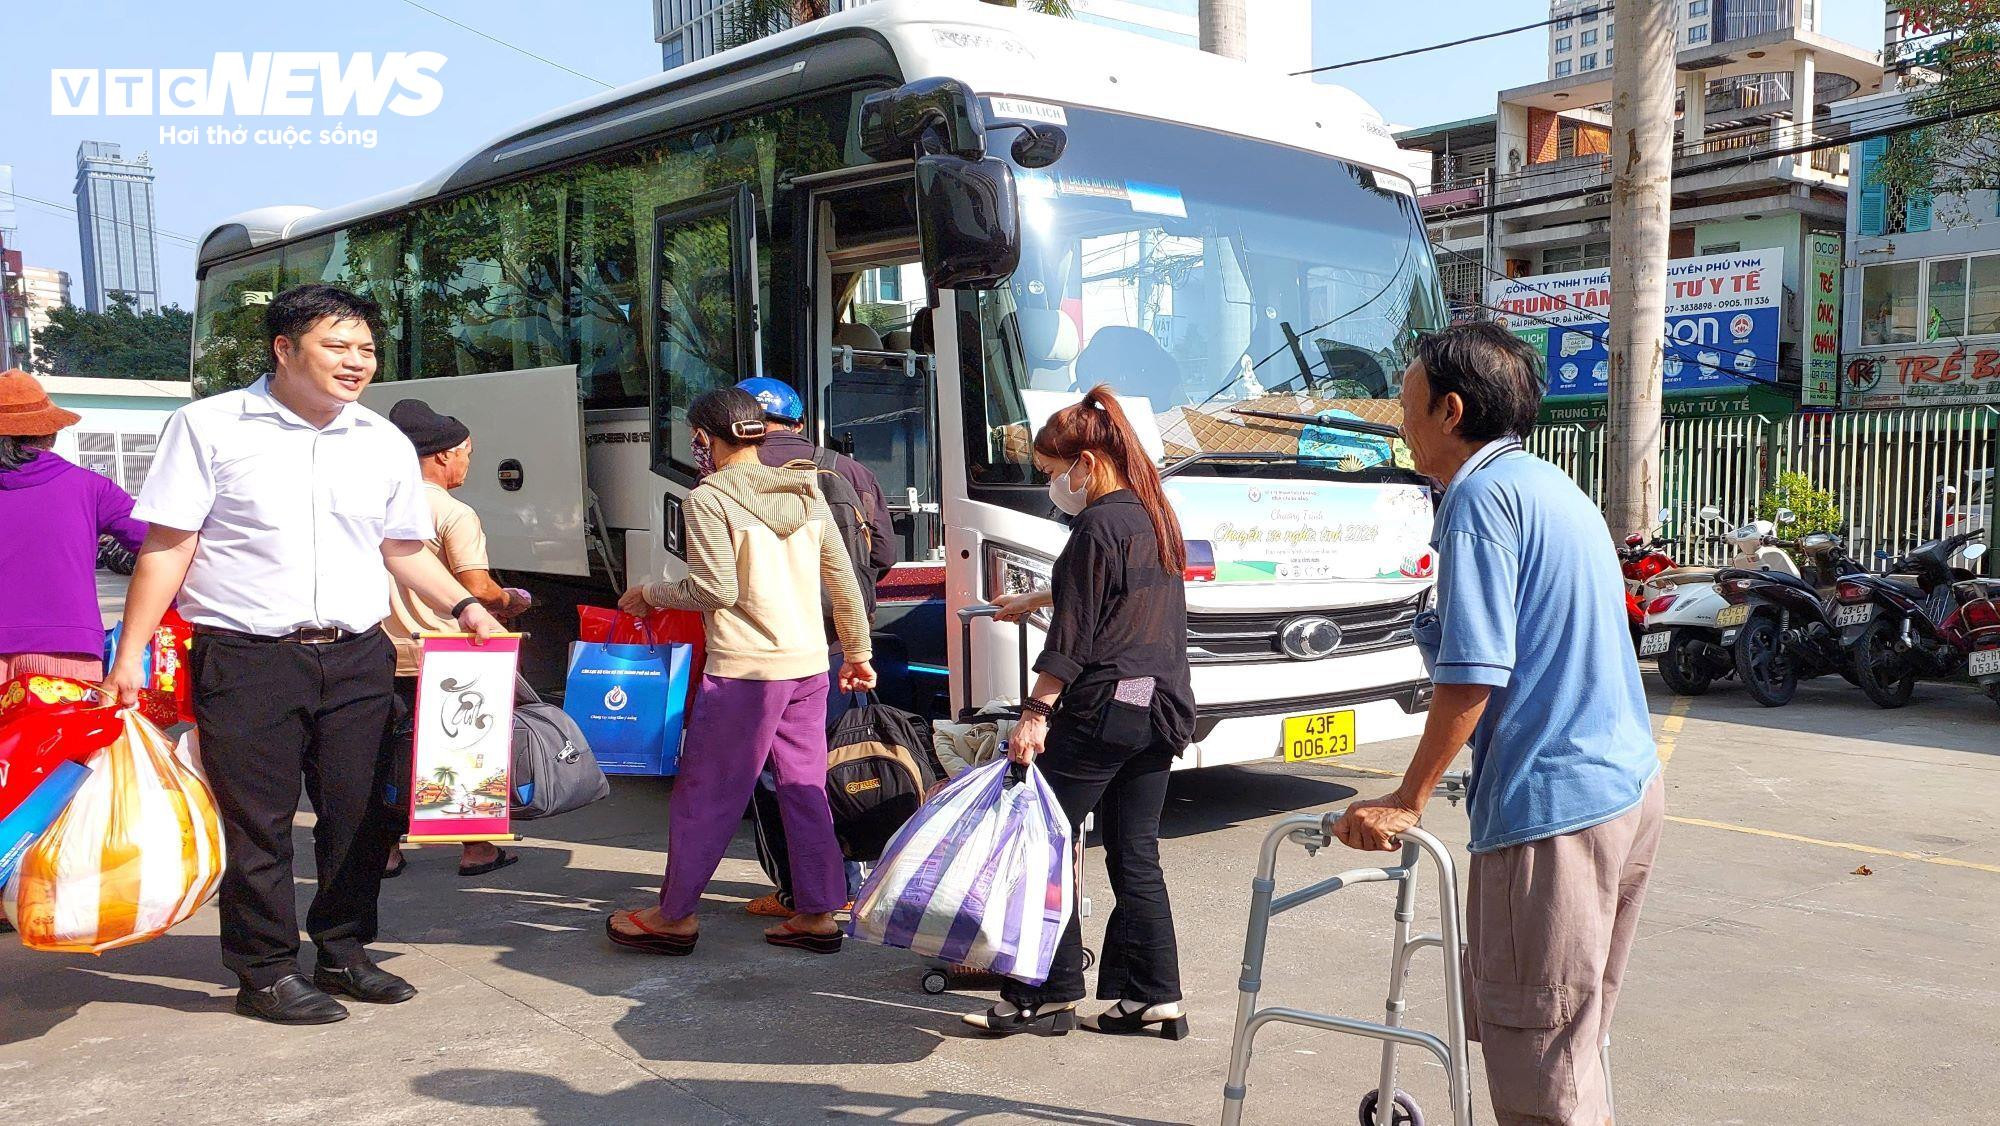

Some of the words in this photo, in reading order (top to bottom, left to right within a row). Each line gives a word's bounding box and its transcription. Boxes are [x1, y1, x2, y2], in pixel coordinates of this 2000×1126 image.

[1705, 258, 1731, 272] PHÚ
[1734, 258, 1761, 268] VNM
[1505, 282, 1535, 294] CÔNG
[1537, 282, 1550, 291] TY
[1552, 278, 1580, 290] TNHH
[1673, 276, 1706, 299] TƯ
[1709, 277, 1724, 295] Y
[1731, 267, 1766, 293] TẾ
[1500, 294, 1568, 316] TRUNG
[1680, 301, 1713, 313] 3838898
[1755, 296, 1770, 305] 336
[1895, 346, 1964, 385] TRÉ
[1549, 407, 1588, 419] TRUNG
[1669, 402, 1695, 417] VẬT
[1699, 400, 1718, 414] TƯ
[1719, 401, 1730, 413] Y
[1732, 396, 1751, 412] TẾ
[1344, 523, 1379, 543] 2024
[1305, 715, 1335, 735] 43F
[1293, 734, 1348, 759] 006.23
